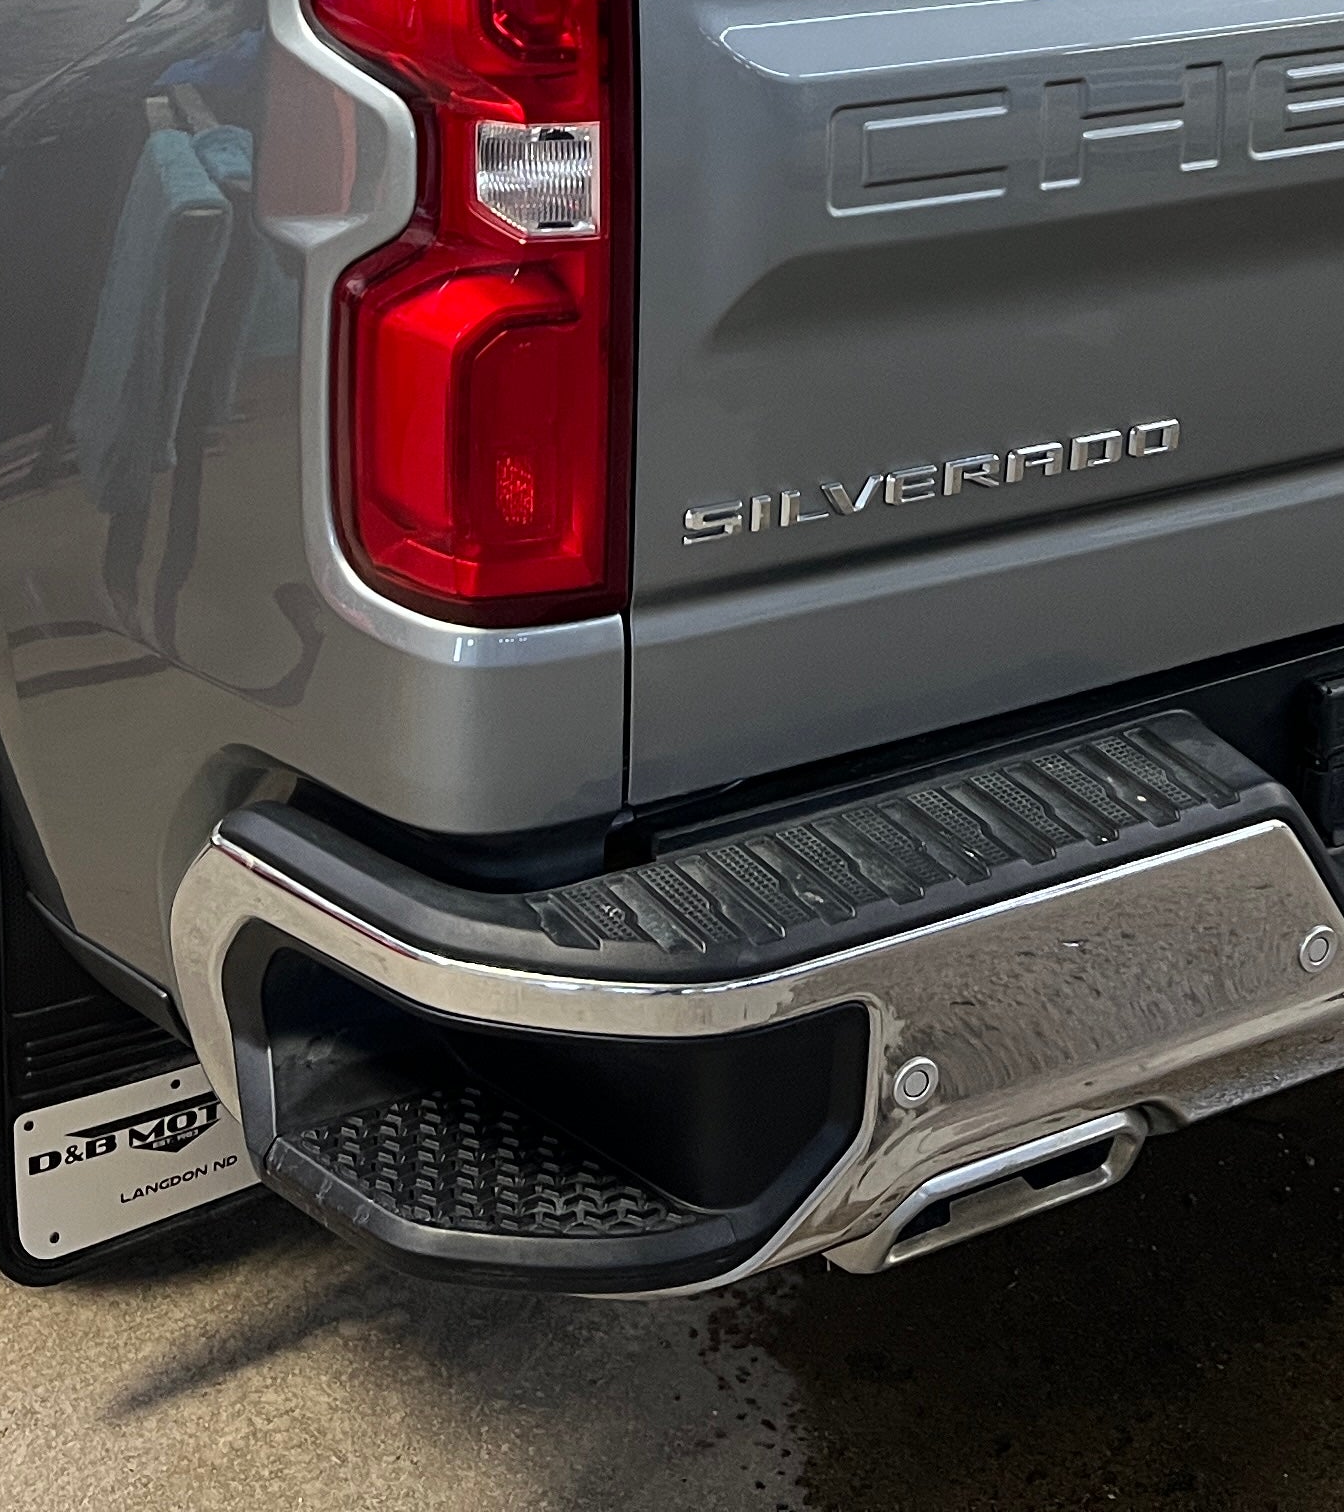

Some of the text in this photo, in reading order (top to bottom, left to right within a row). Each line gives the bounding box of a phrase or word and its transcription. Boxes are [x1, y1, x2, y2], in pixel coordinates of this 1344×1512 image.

[682, 418, 1180, 546] SILVERADO
[28, 1101, 222, 1176] D&B MOT
[119, 1154, 239, 1204] LANGDON ND
